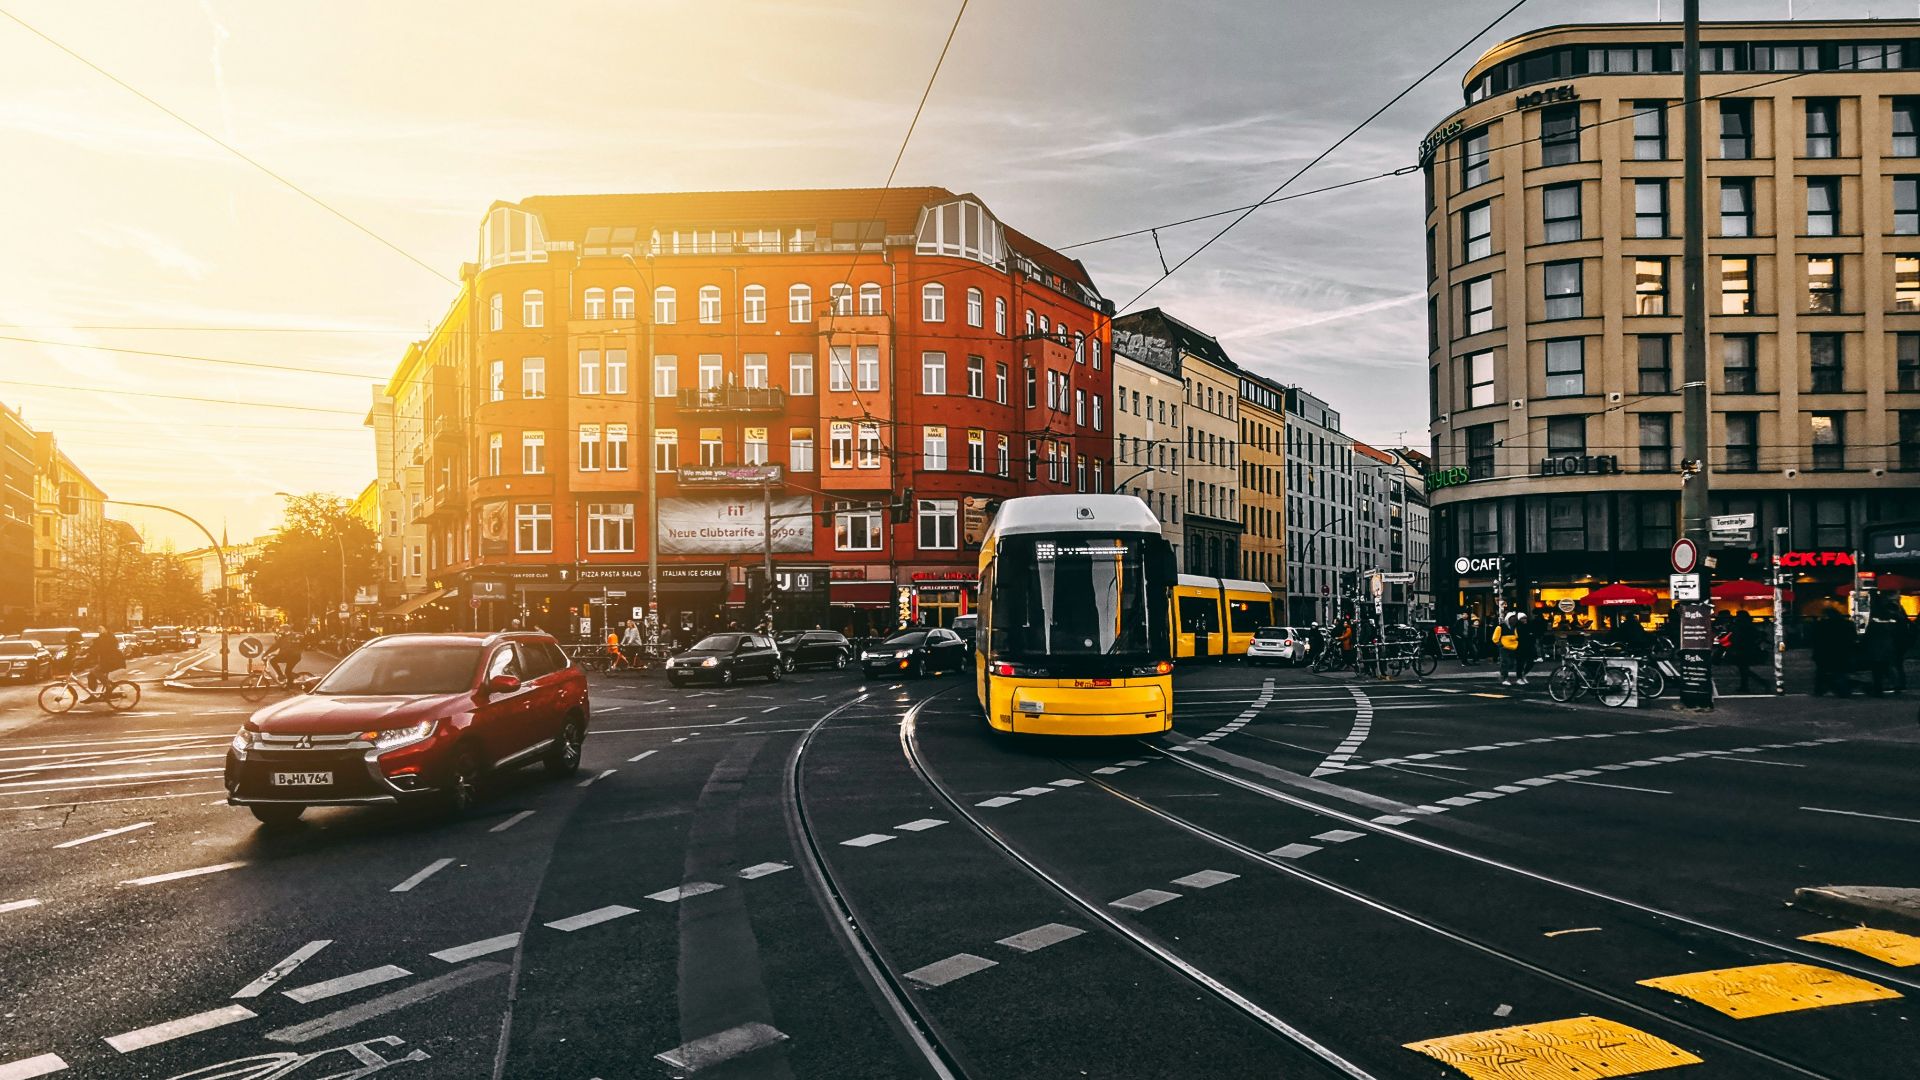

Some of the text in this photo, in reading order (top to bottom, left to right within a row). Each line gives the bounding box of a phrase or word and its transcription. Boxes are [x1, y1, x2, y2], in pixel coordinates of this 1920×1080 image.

[1516, 85, 1580, 110] HOTEL
[1541, 455, 1624, 475] HOTEL
[714, 470, 727, 478] you
[669, 529, 697, 538] Neue
[700, 528, 755, 538] Clubtarife
[770, 528, 795, 539] 9,90
[1894, 535, 1905, 549] U
[1772, 551, 1857, 567] CK-FA
[485, 583, 493, 592] U
[279, 773, 329, 785] B HA 764
